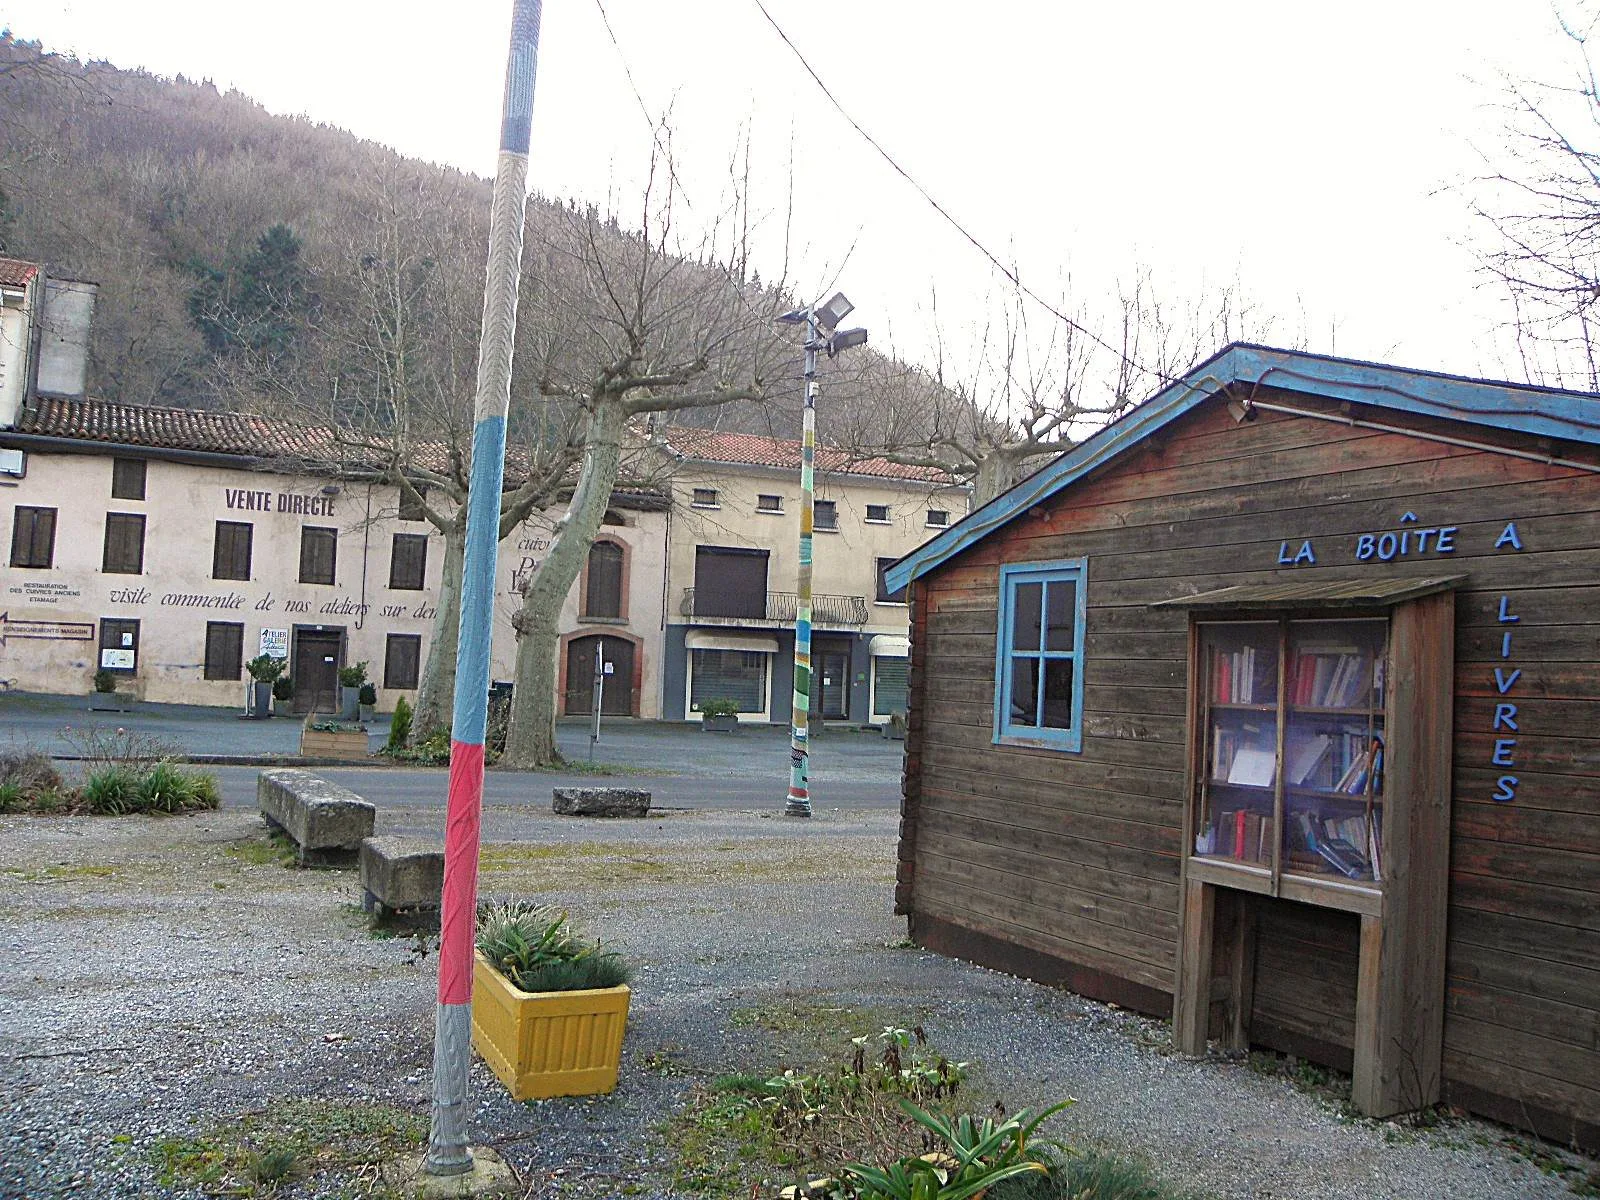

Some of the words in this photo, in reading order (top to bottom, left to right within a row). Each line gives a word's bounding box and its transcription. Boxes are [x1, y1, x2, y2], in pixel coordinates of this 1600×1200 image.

[225, 488, 272, 512] VENTE
[277, 493, 337, 517] DIRECTE
[1278, 540, 1316, 565] LA
[1355, 511, 1459, 561] BOÎTE
[1494, 522, 1524, 551] A
[23, 582, 69, 590] RESTAURATION
[110, 587, 151, 605] visite
[160, 591, 246, 609] commentée
[255, 592, 276, 611] de
[285, 599, 312, 613] nos
[320, 596, 371, 617] ateliers
[379, 604, 406, 617] sur
[261, 629, 287, 638] ATELIER
[1491, 596, 1521, 802] LIVRES
